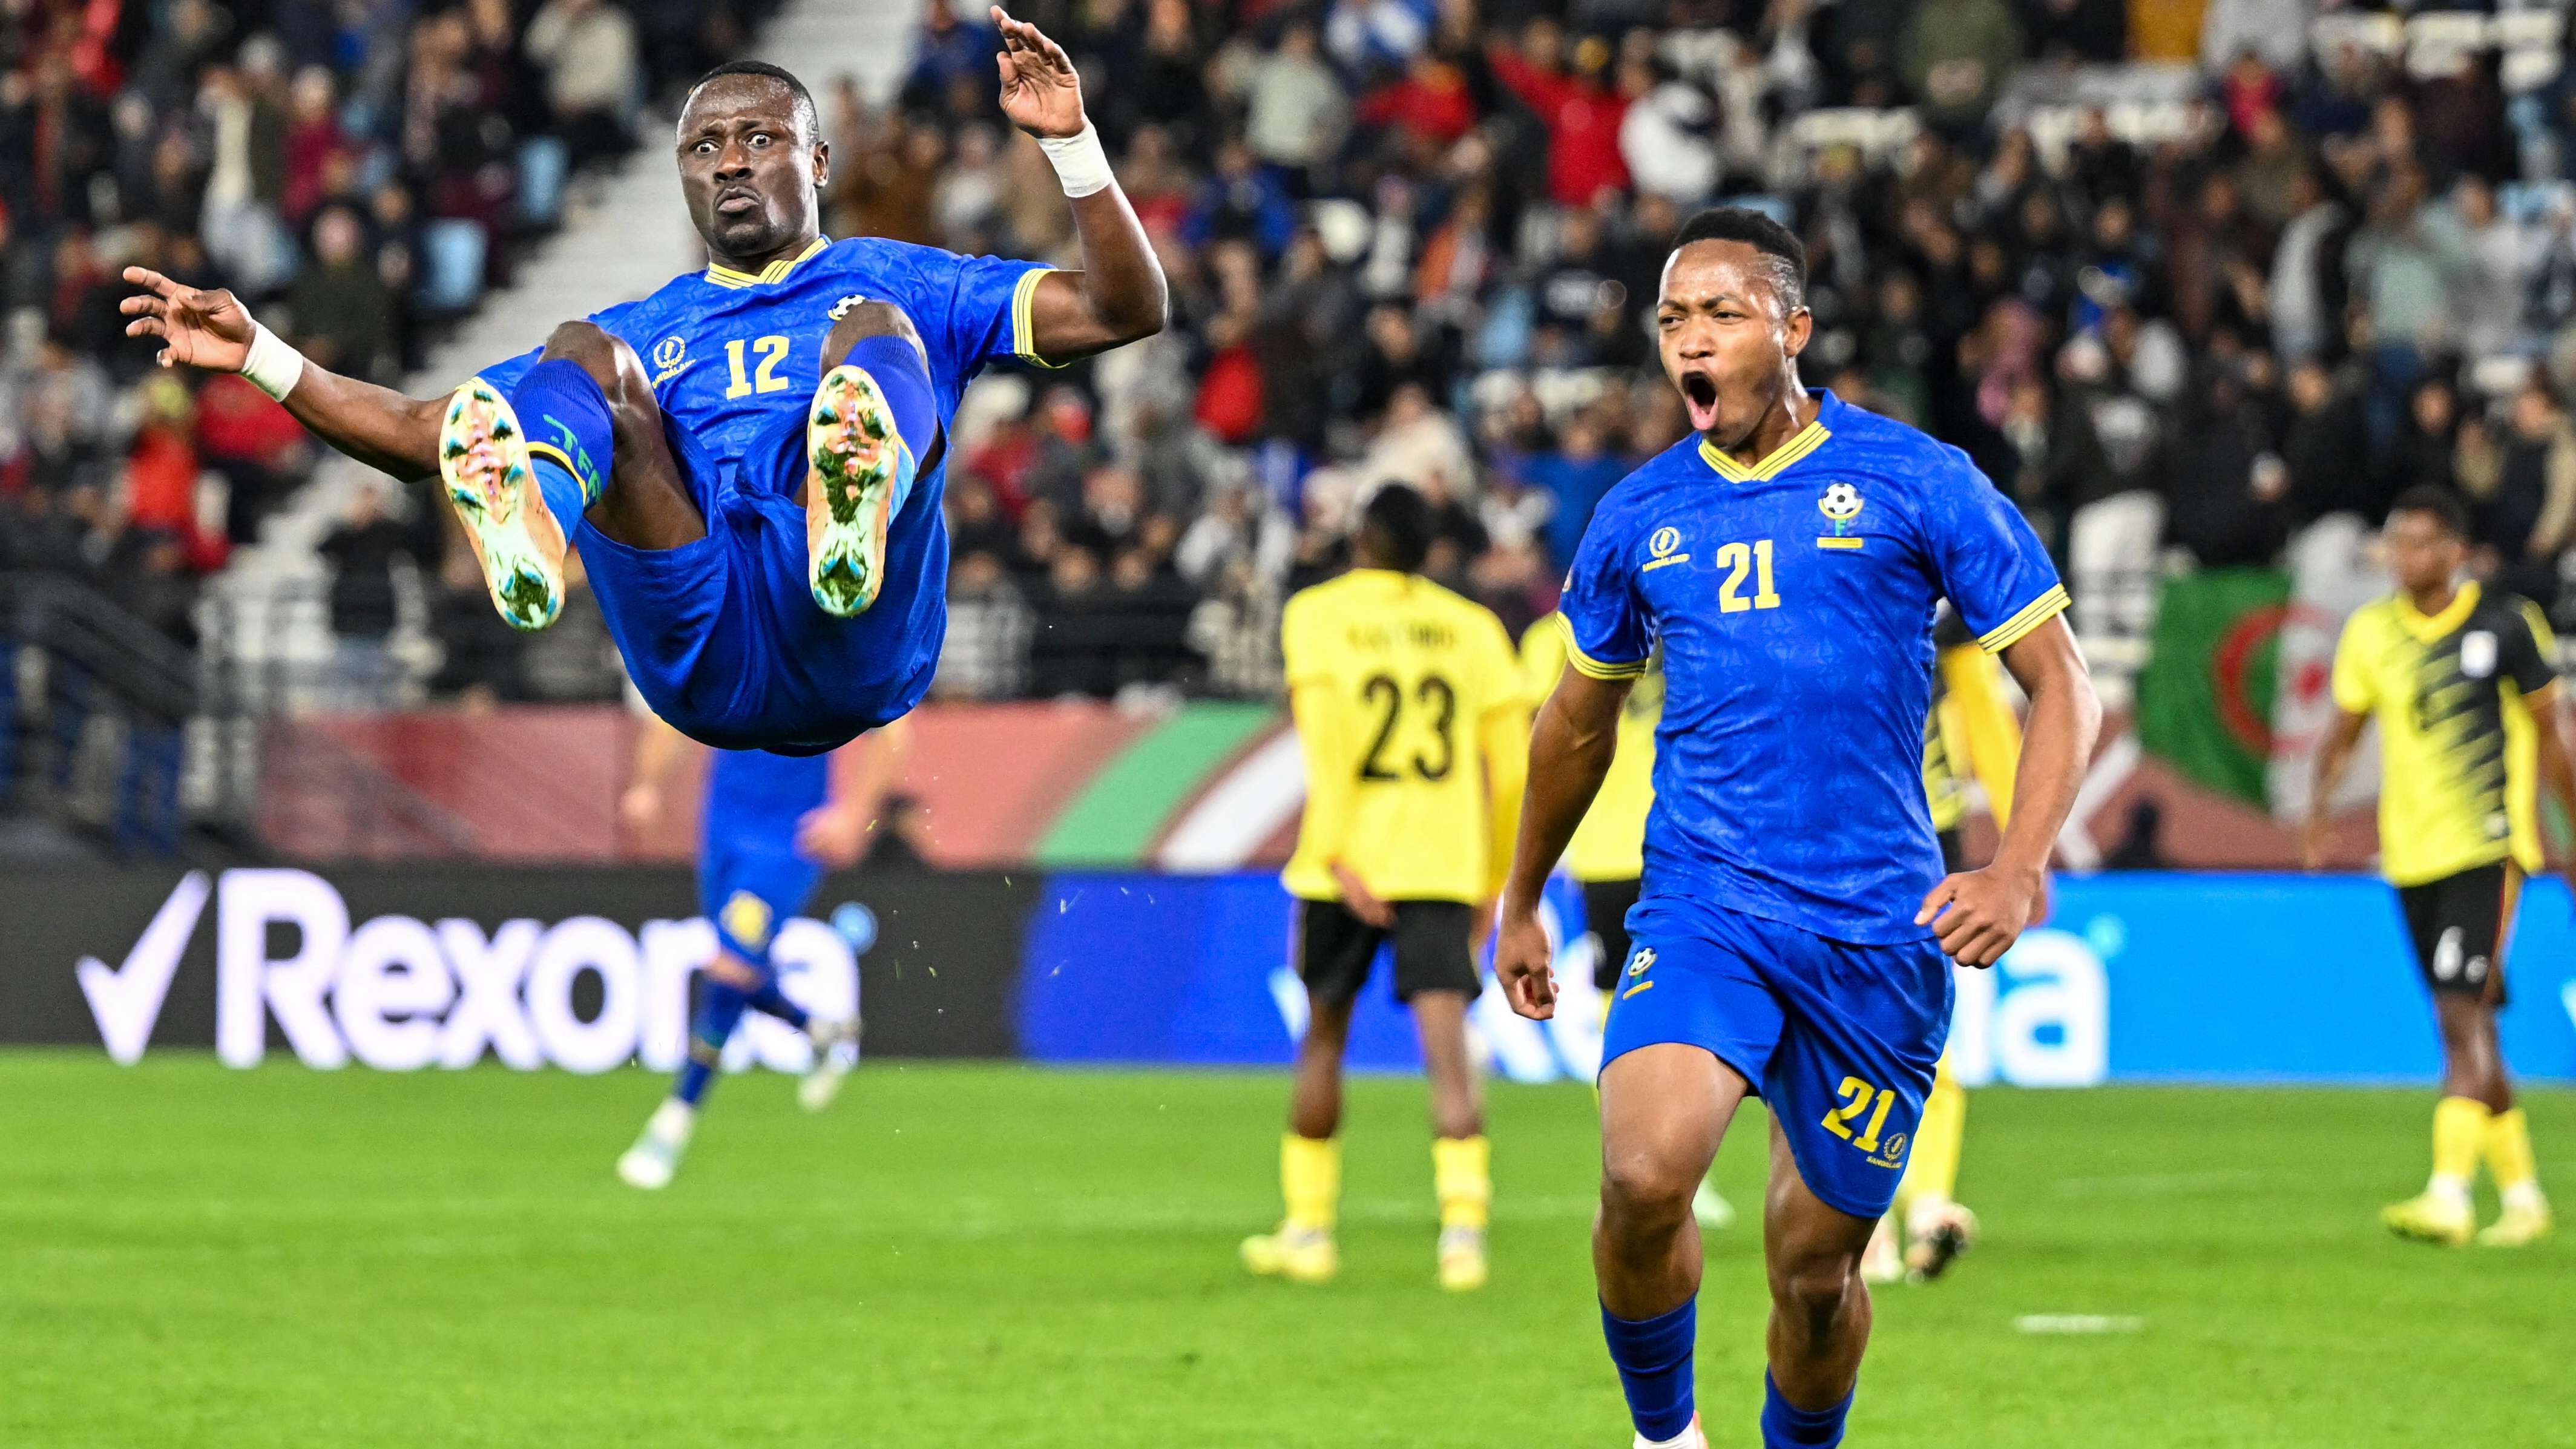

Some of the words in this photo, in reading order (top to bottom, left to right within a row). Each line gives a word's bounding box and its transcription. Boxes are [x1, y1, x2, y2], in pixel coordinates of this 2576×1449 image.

[724, 335, 789, 399] 12
[1717, 539, 1781, 613] 21
[1357, 672, 1456, 782] 23
[214, 867, 862, 1074] Rexona
[1821, 1076, 1896, 1152] 21
